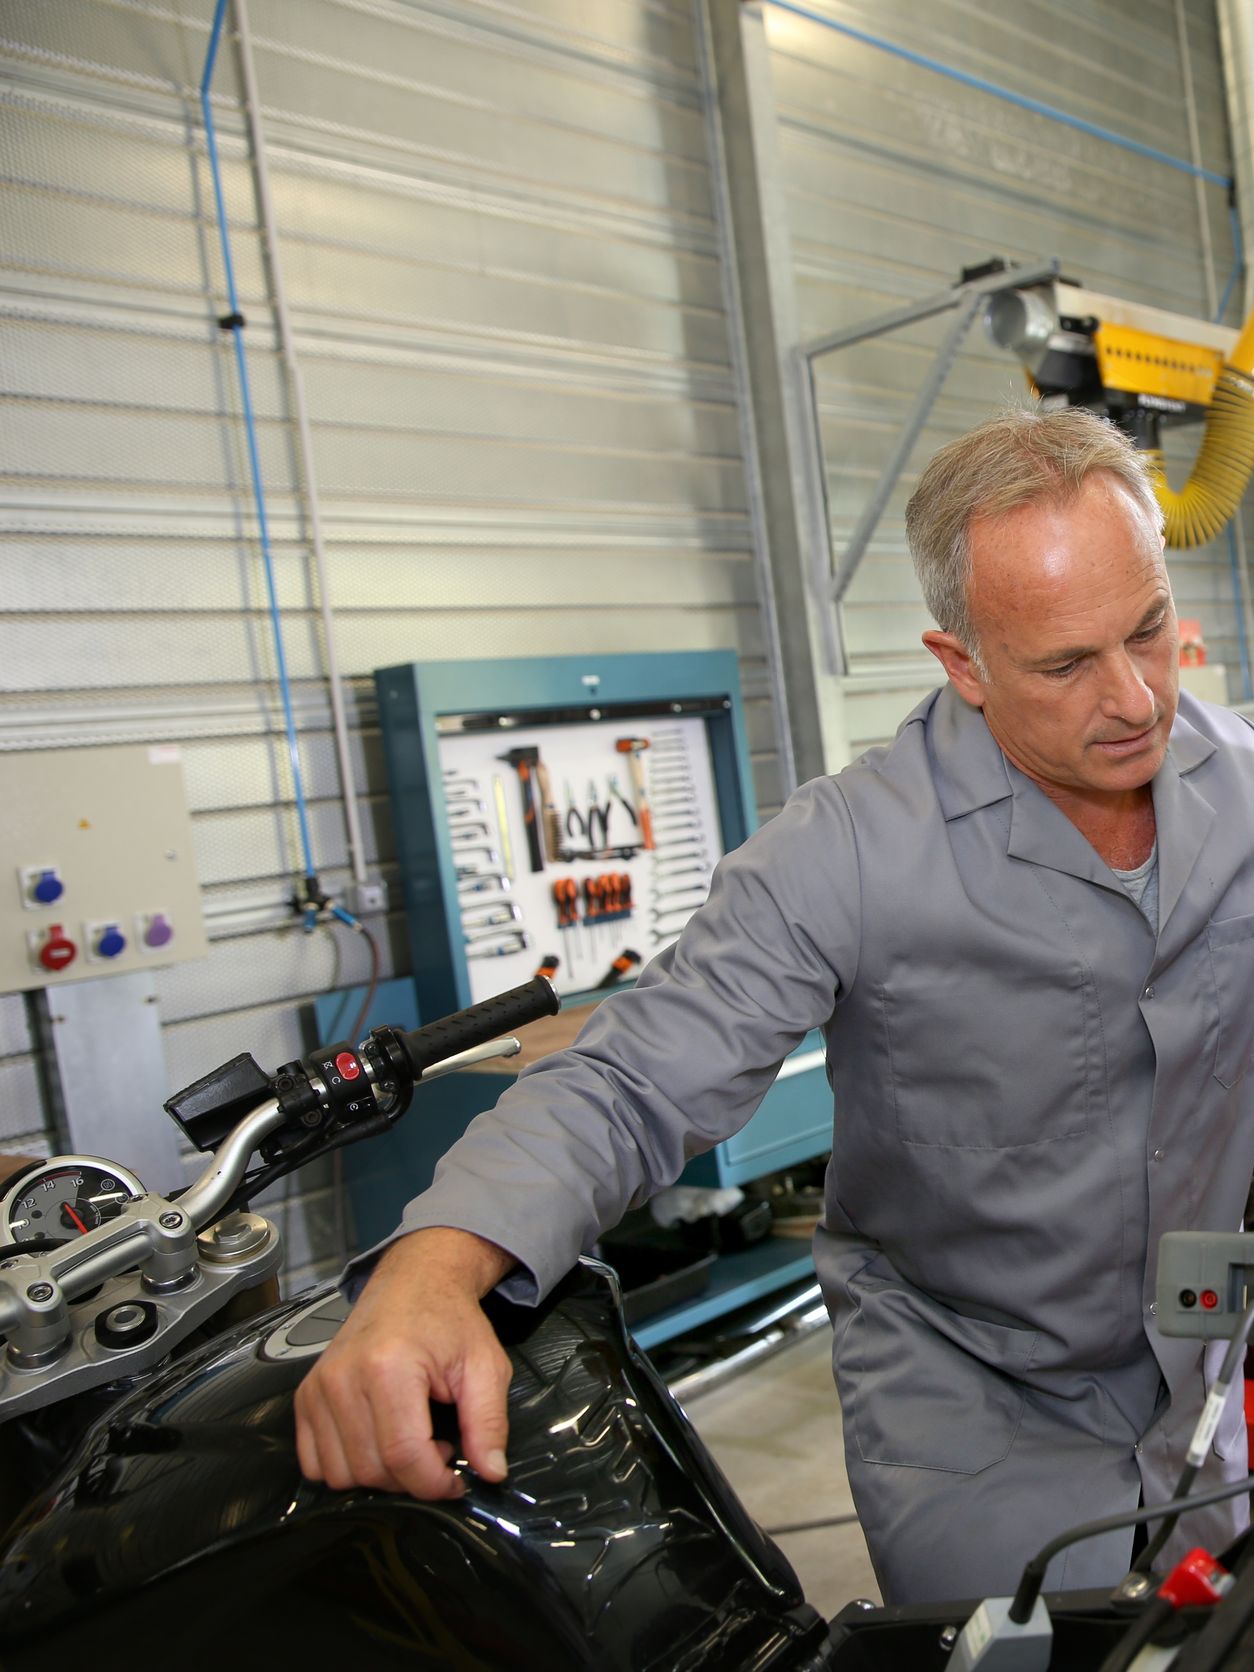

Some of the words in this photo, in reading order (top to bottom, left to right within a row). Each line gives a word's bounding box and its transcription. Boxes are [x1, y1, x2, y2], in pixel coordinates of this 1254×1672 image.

[41, 1180, 56, 1192] 14
[71, 1177, 84, 1188] 16
[22, 1198, 37, 1209] 12
